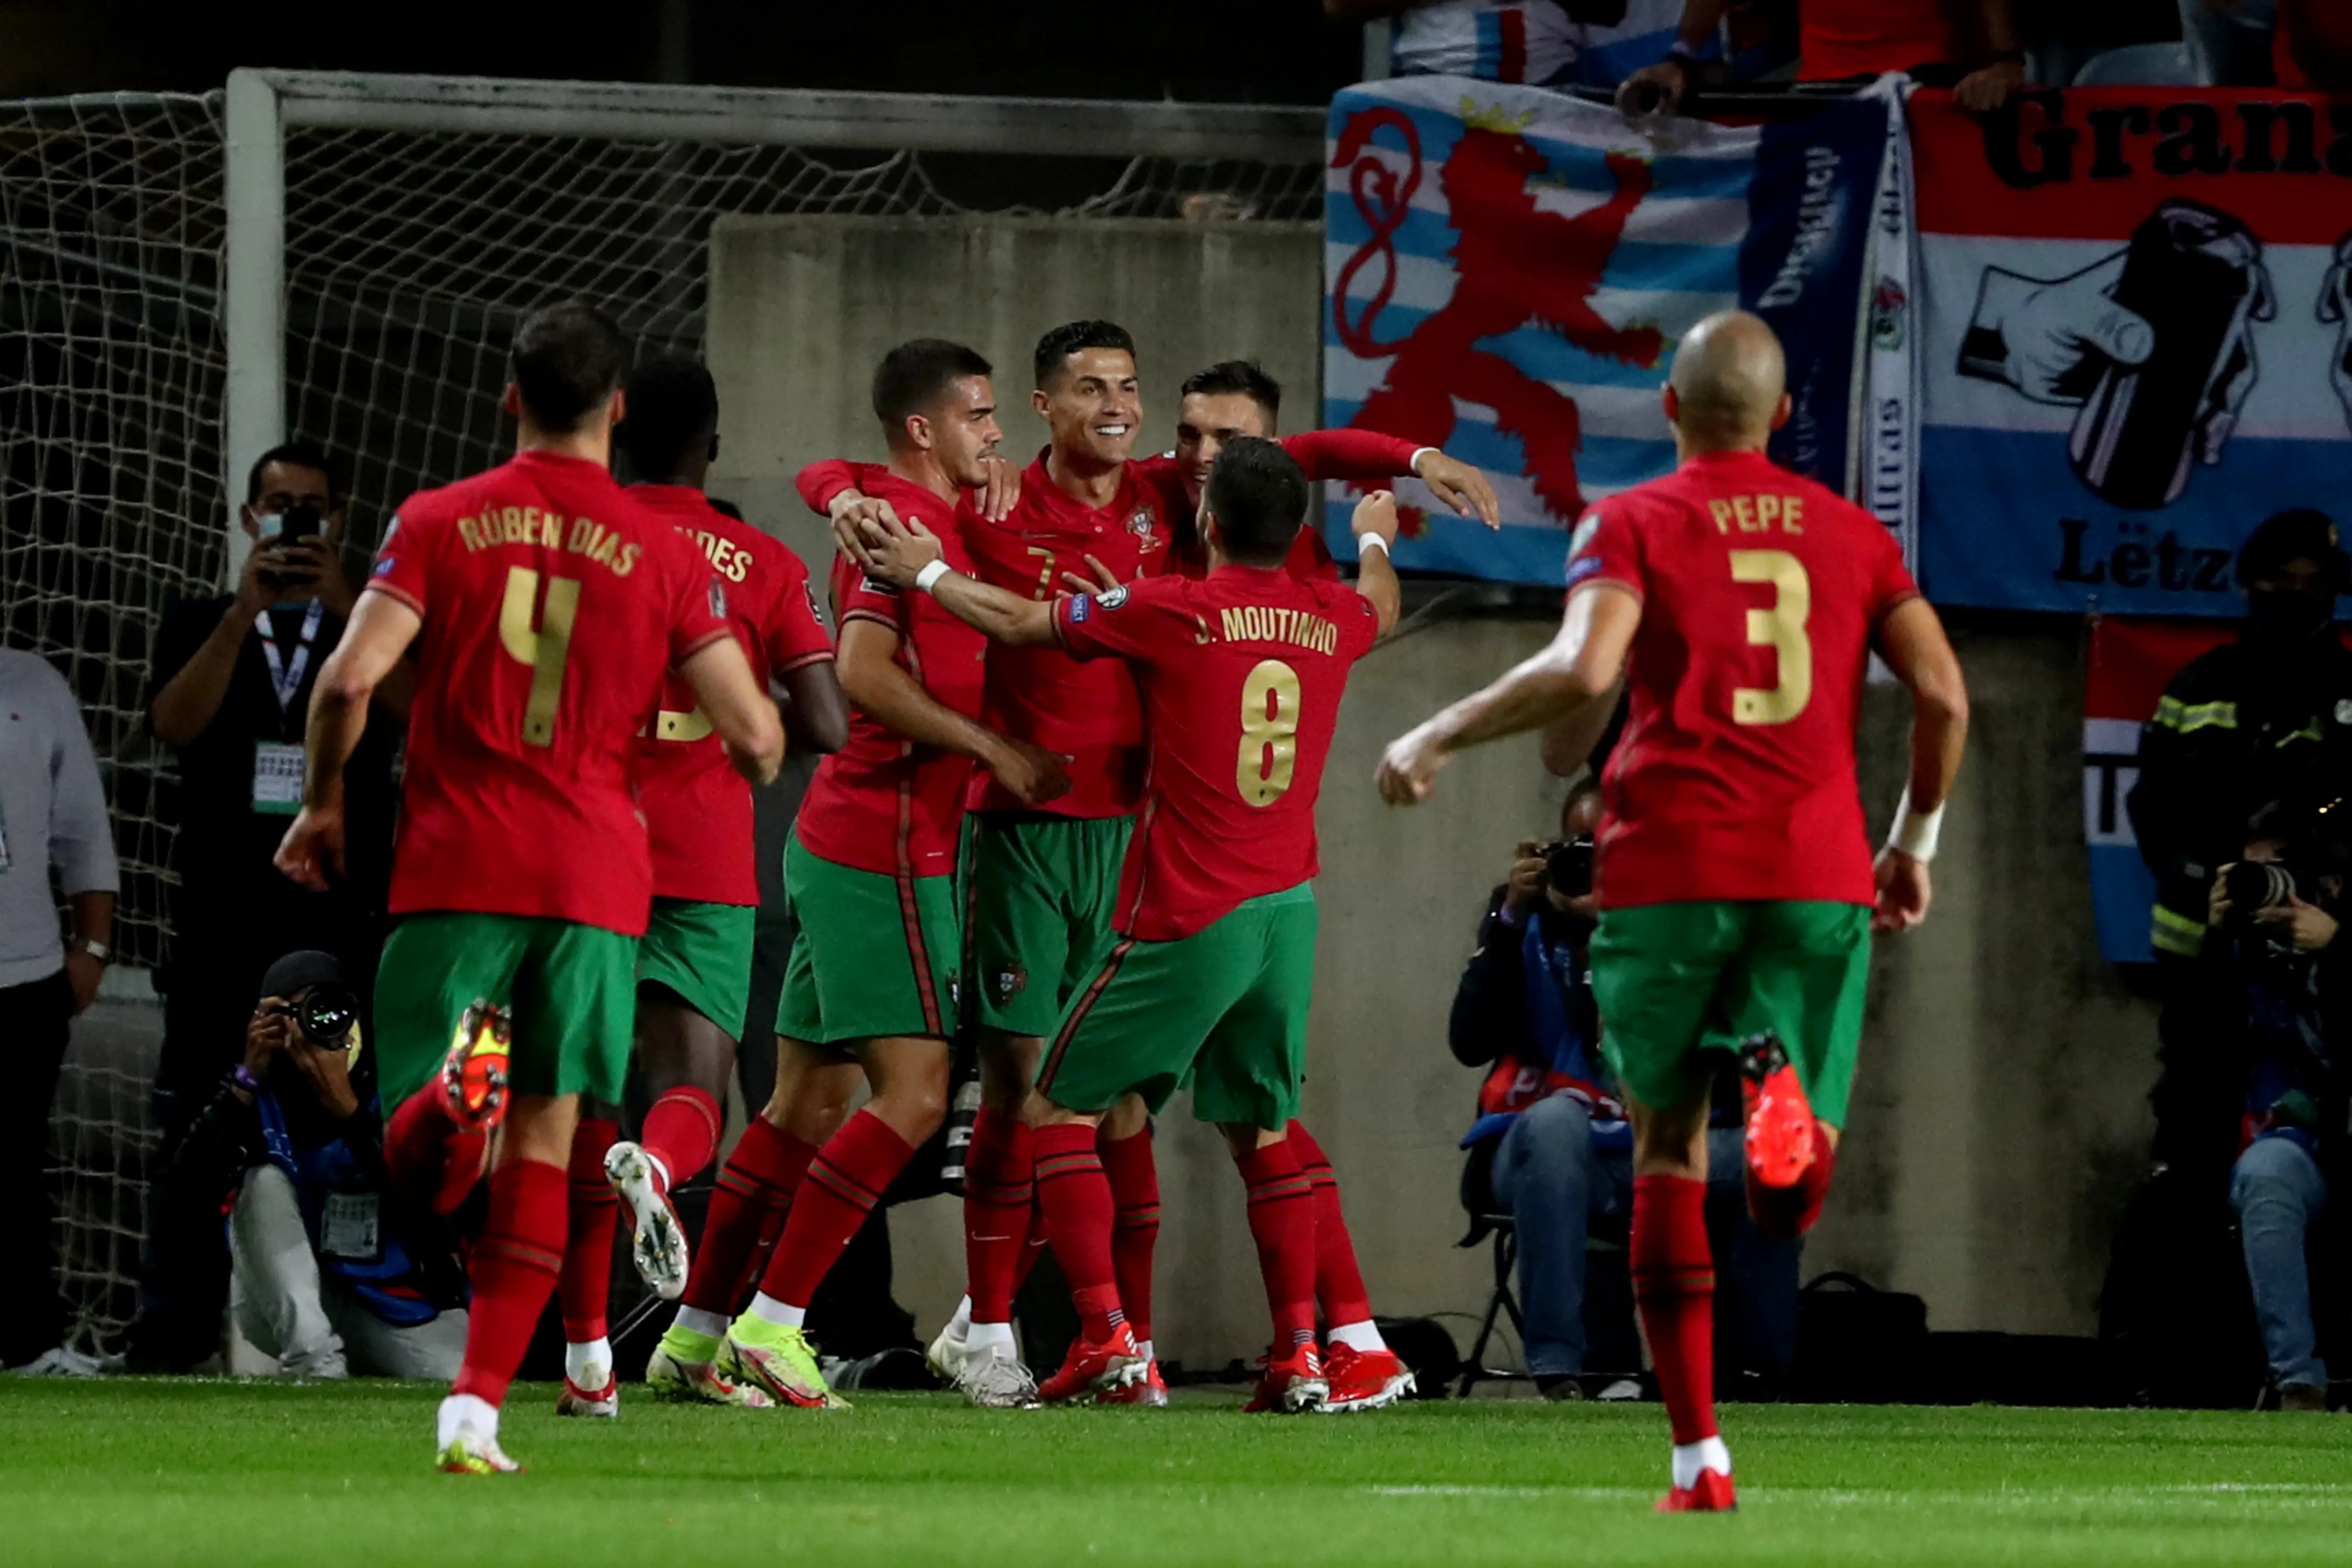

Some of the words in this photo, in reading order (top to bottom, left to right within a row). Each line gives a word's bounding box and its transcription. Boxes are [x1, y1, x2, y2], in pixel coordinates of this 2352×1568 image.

[457, 500, 563, 553] RÚBEN
[567, 516, 642, 577] DIAS
[1707, 493, 1805, 536] PEPE
[673, 525, 754, 583] DES
[1027, 546, 1056, 602] 7
[499, 565, 582, 748] 4
[1194, 613, 1217, 645] J.
[1220, 606, 1338, 656] MOUTINHO
[1728, 549, 1813, 726] 3
[1236, 659, 1301, 808] 8
